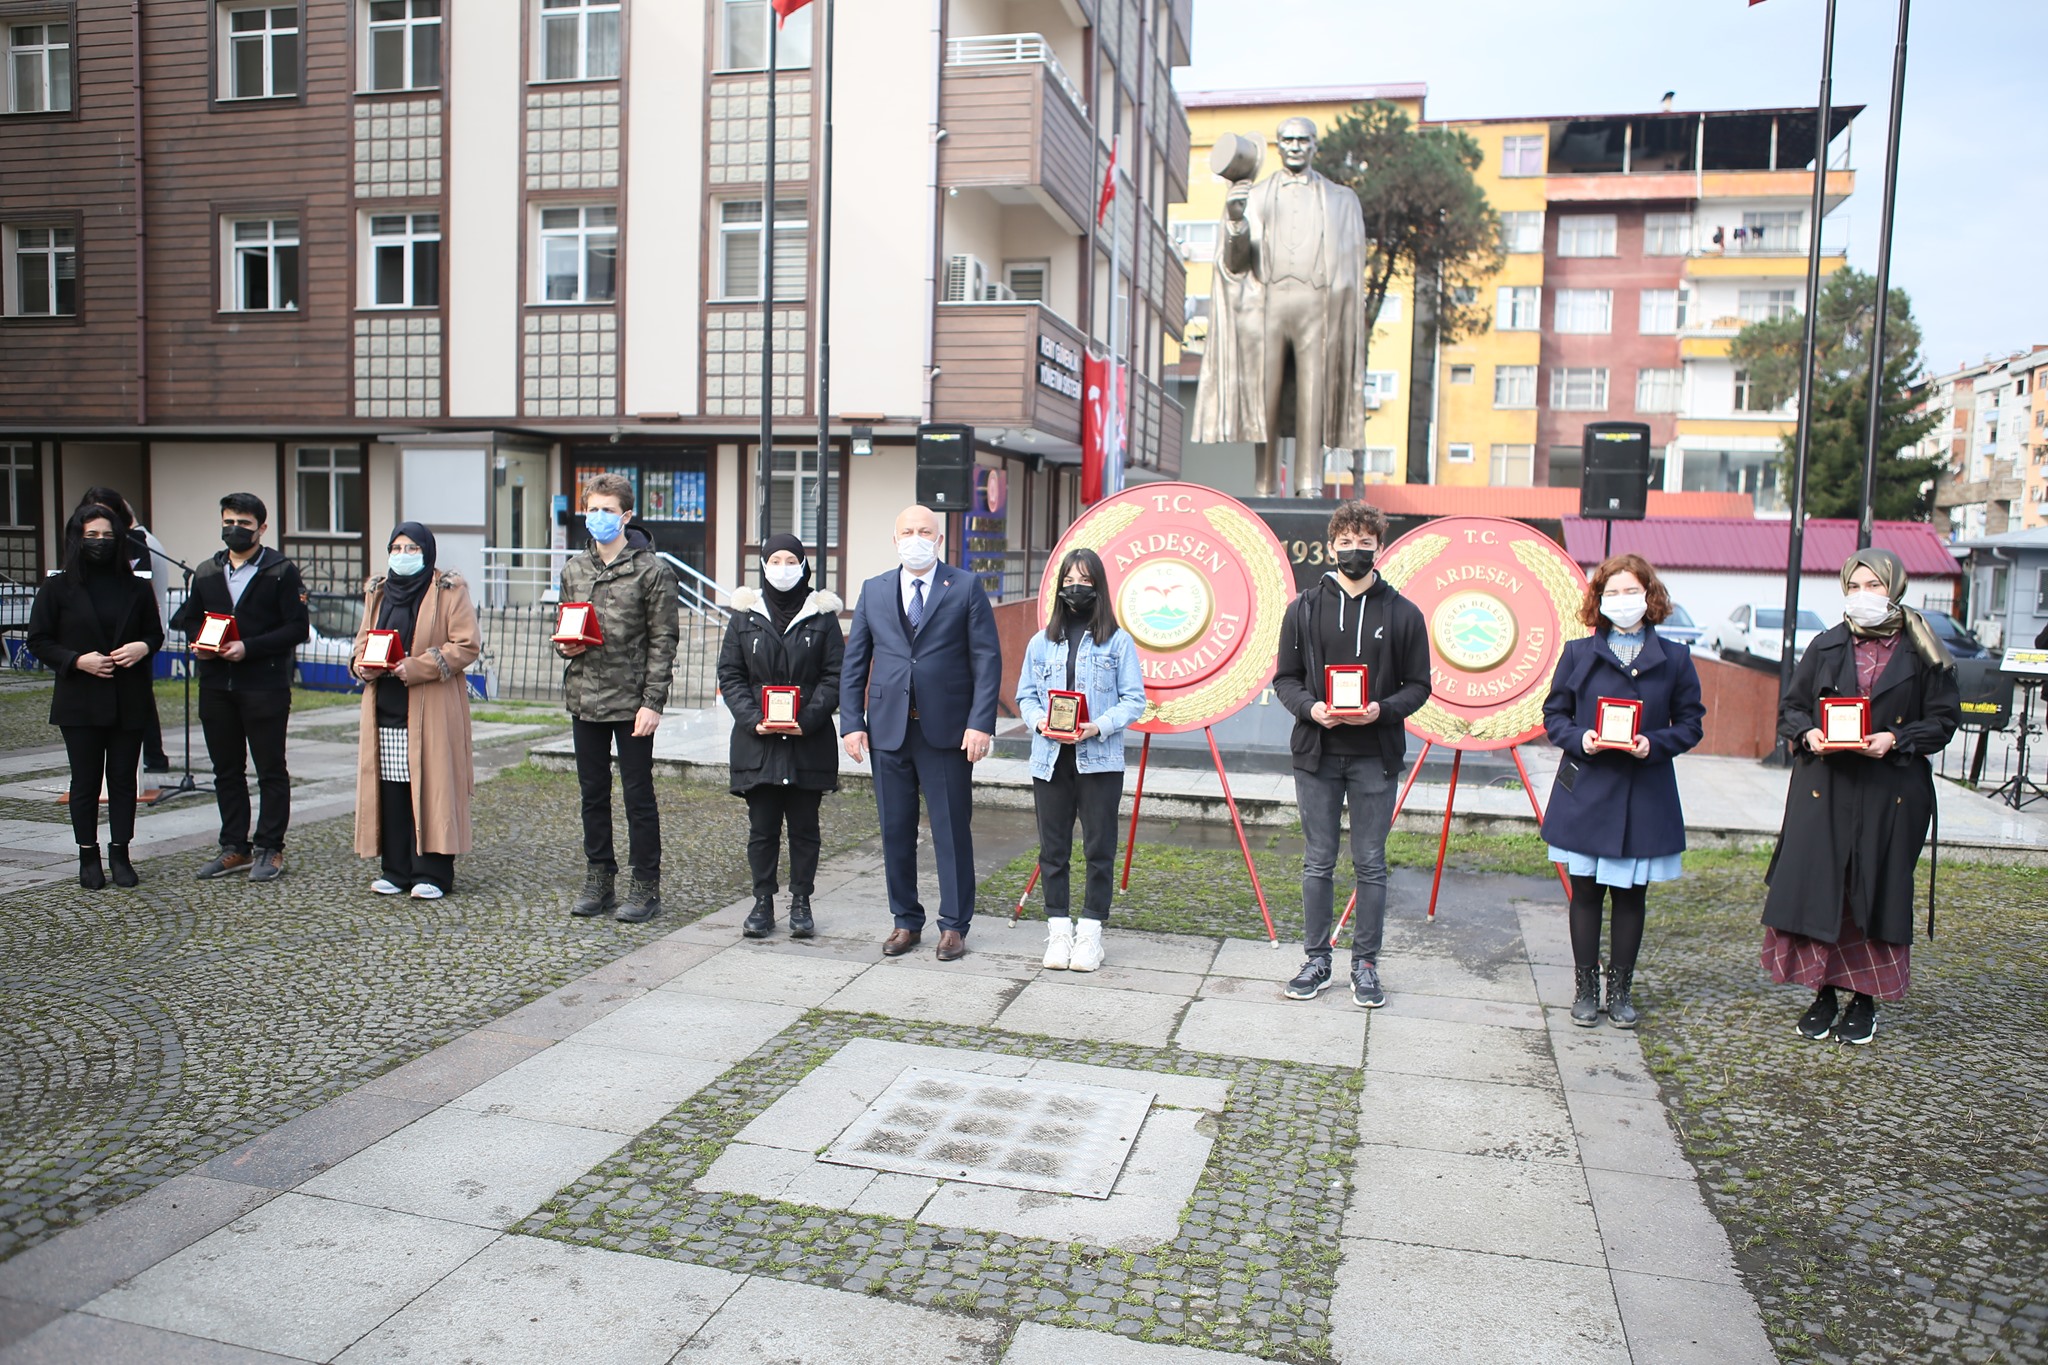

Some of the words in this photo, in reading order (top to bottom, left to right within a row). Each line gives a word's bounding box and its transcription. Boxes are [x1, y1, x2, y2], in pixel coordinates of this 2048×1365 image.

[1152, 494, 1196, 514] T.C.
[1464, 529, 1499, 545] T.C.
[1113, 533, 1228, 575] ARDEŞEN
[1433, 564, 1524, 595] ARDEŞEN
[1466, 626, 1546, 698] BAŞKANLIĞI
